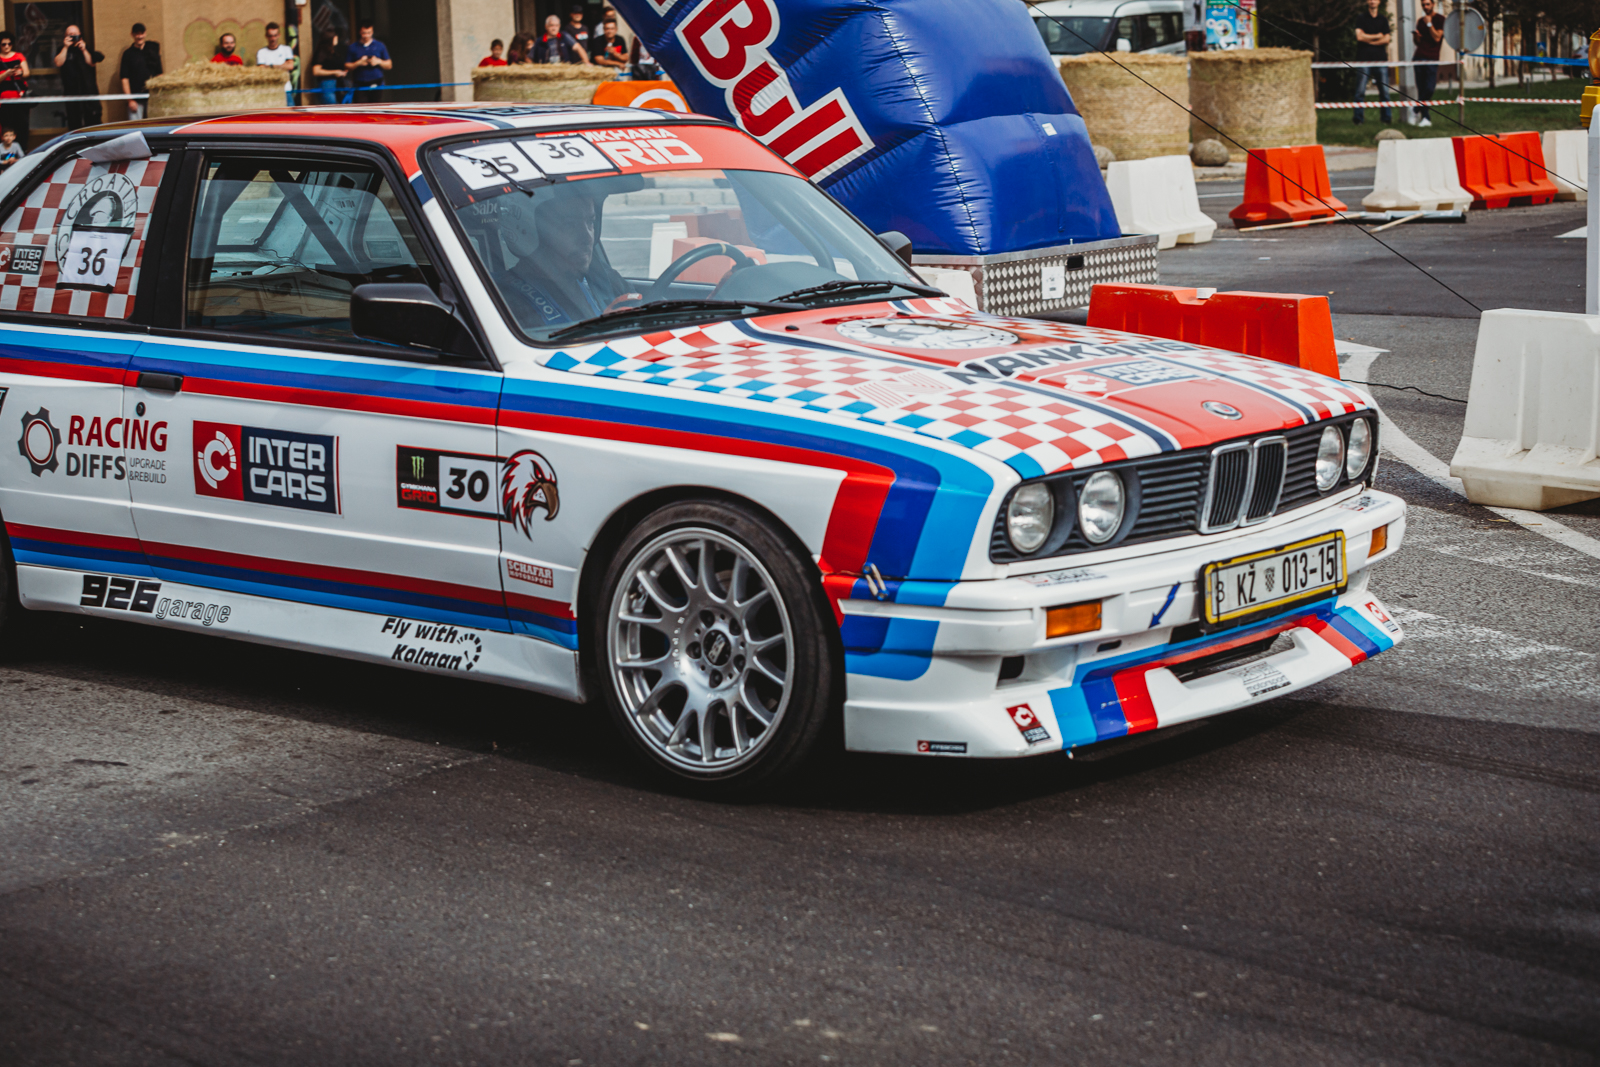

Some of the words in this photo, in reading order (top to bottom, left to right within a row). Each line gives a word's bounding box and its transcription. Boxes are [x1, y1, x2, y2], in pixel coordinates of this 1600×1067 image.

[678, 0, 868, 181] Bull
[550, 128, 678, 142] MKHANA
[538, 141, 585, 159] 36
[597, 138, 704, 168] RiD
[471, 155, 519, 179] 35
[66, 173, 136, 227] CROATIAN
[12, 260, 40, 272] CARS
[14, 248, 42, 260] INTER
[77, 246, 108, 276] 36
[944, 344, 1202, 386] NANKANG
[68, 415, 168, 452] RACING
[66, 452, 126, 480] DIFFS
[129, 457, 166, 471] UPGRADE
[248, 436, 326, 472] INTER
[129, 471, 167, 484] &REBUILD
[249, 467, 327, 503] CARS
[445, 467, 490, 503] 30
[508, 560, 553, 579] SCHAFAR
[1237, 563, 1256, 606] KŽ
[1283, 544, 1335, 593] 013-15
[80, 574, 162, 614] 926
[156, 597, 231, 626] garage
[381, 617, 412, 639] Fly
[415, 623, 458, 643] with
[391, 643, 462, 670] Kalman
